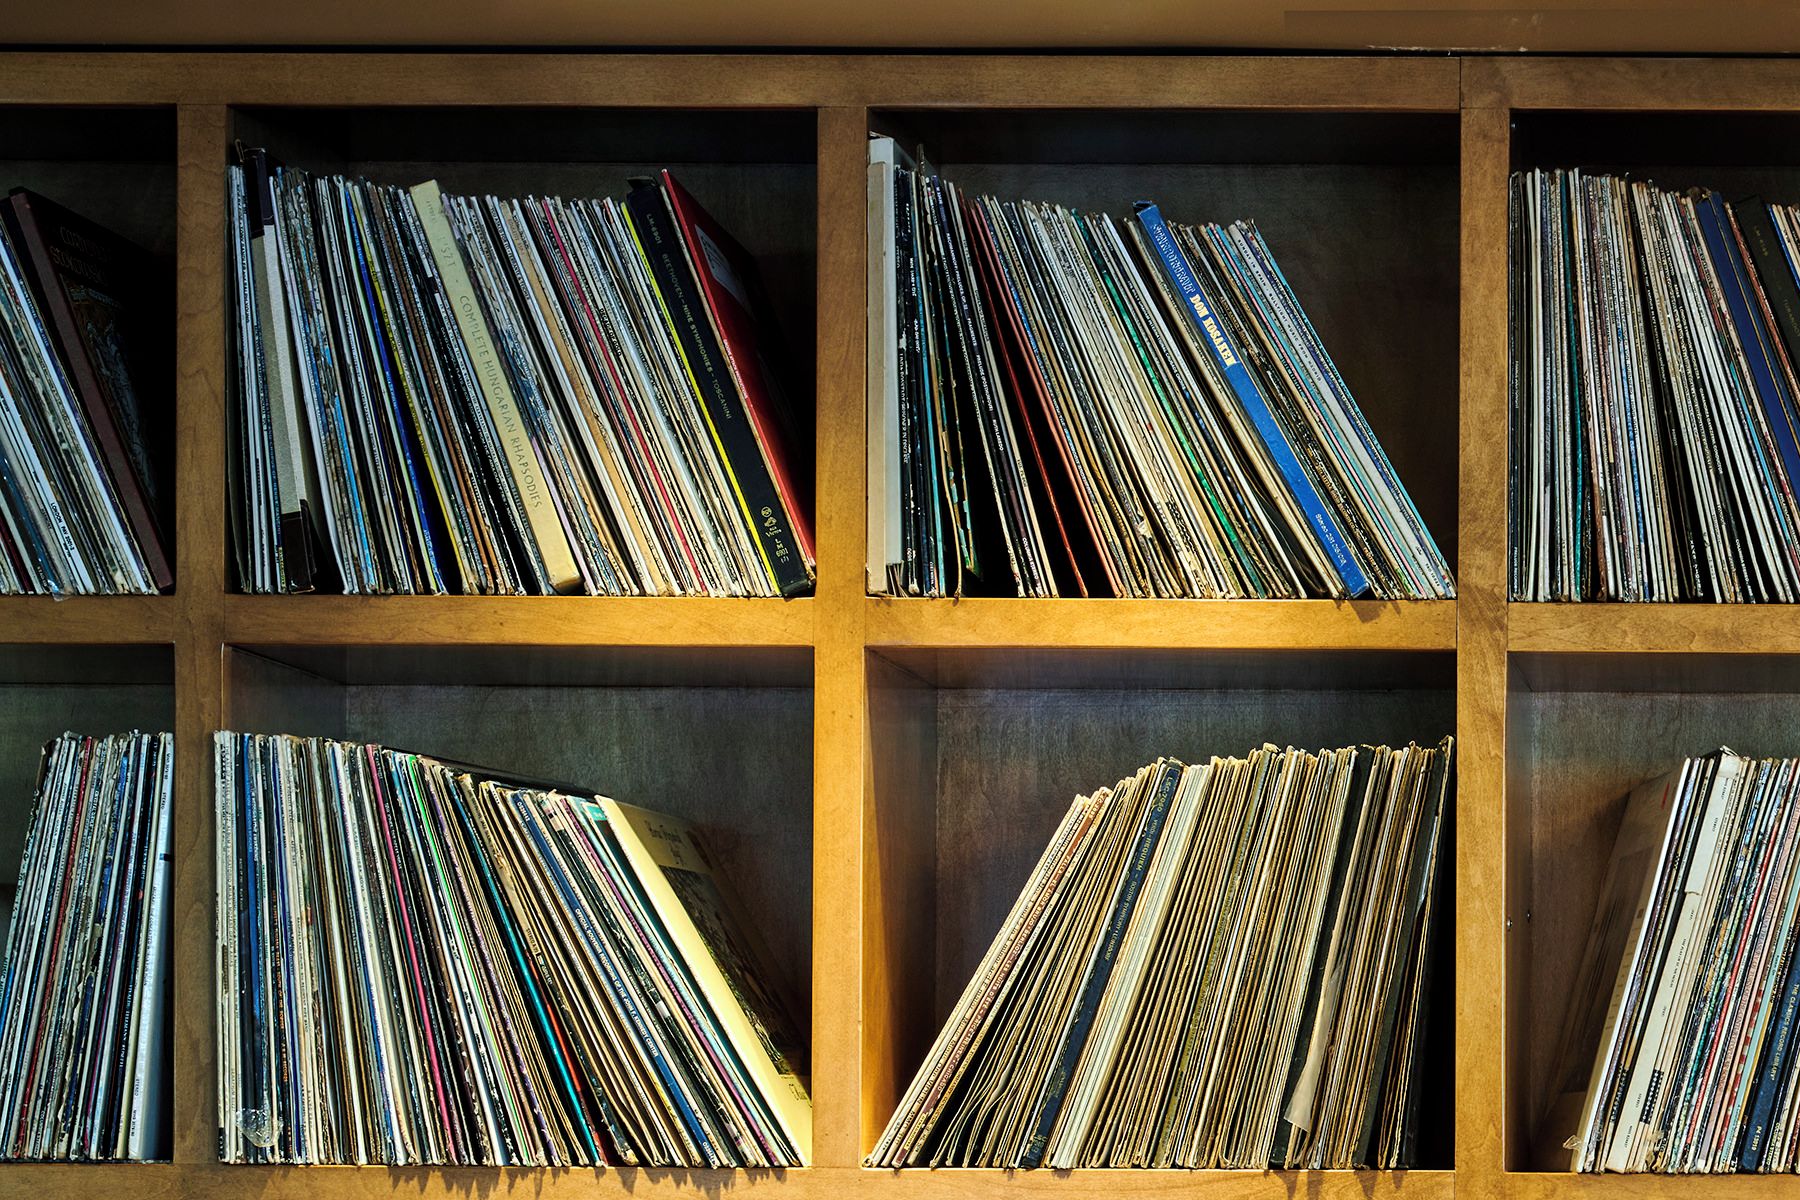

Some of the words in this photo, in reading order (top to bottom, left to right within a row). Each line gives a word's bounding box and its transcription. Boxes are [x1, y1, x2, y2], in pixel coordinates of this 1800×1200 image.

[459, 295, 487, 355] COMPLETE
[482, 360, 516, 432] HUNGARIAN
[510, 437, 543, 507] RHAPSODIES
[1790, 984, 1799, 996] THE
[1782, 996, 1796, 1025] CLASSICS
[1776, 1026, 1788, 1050] RECORD
